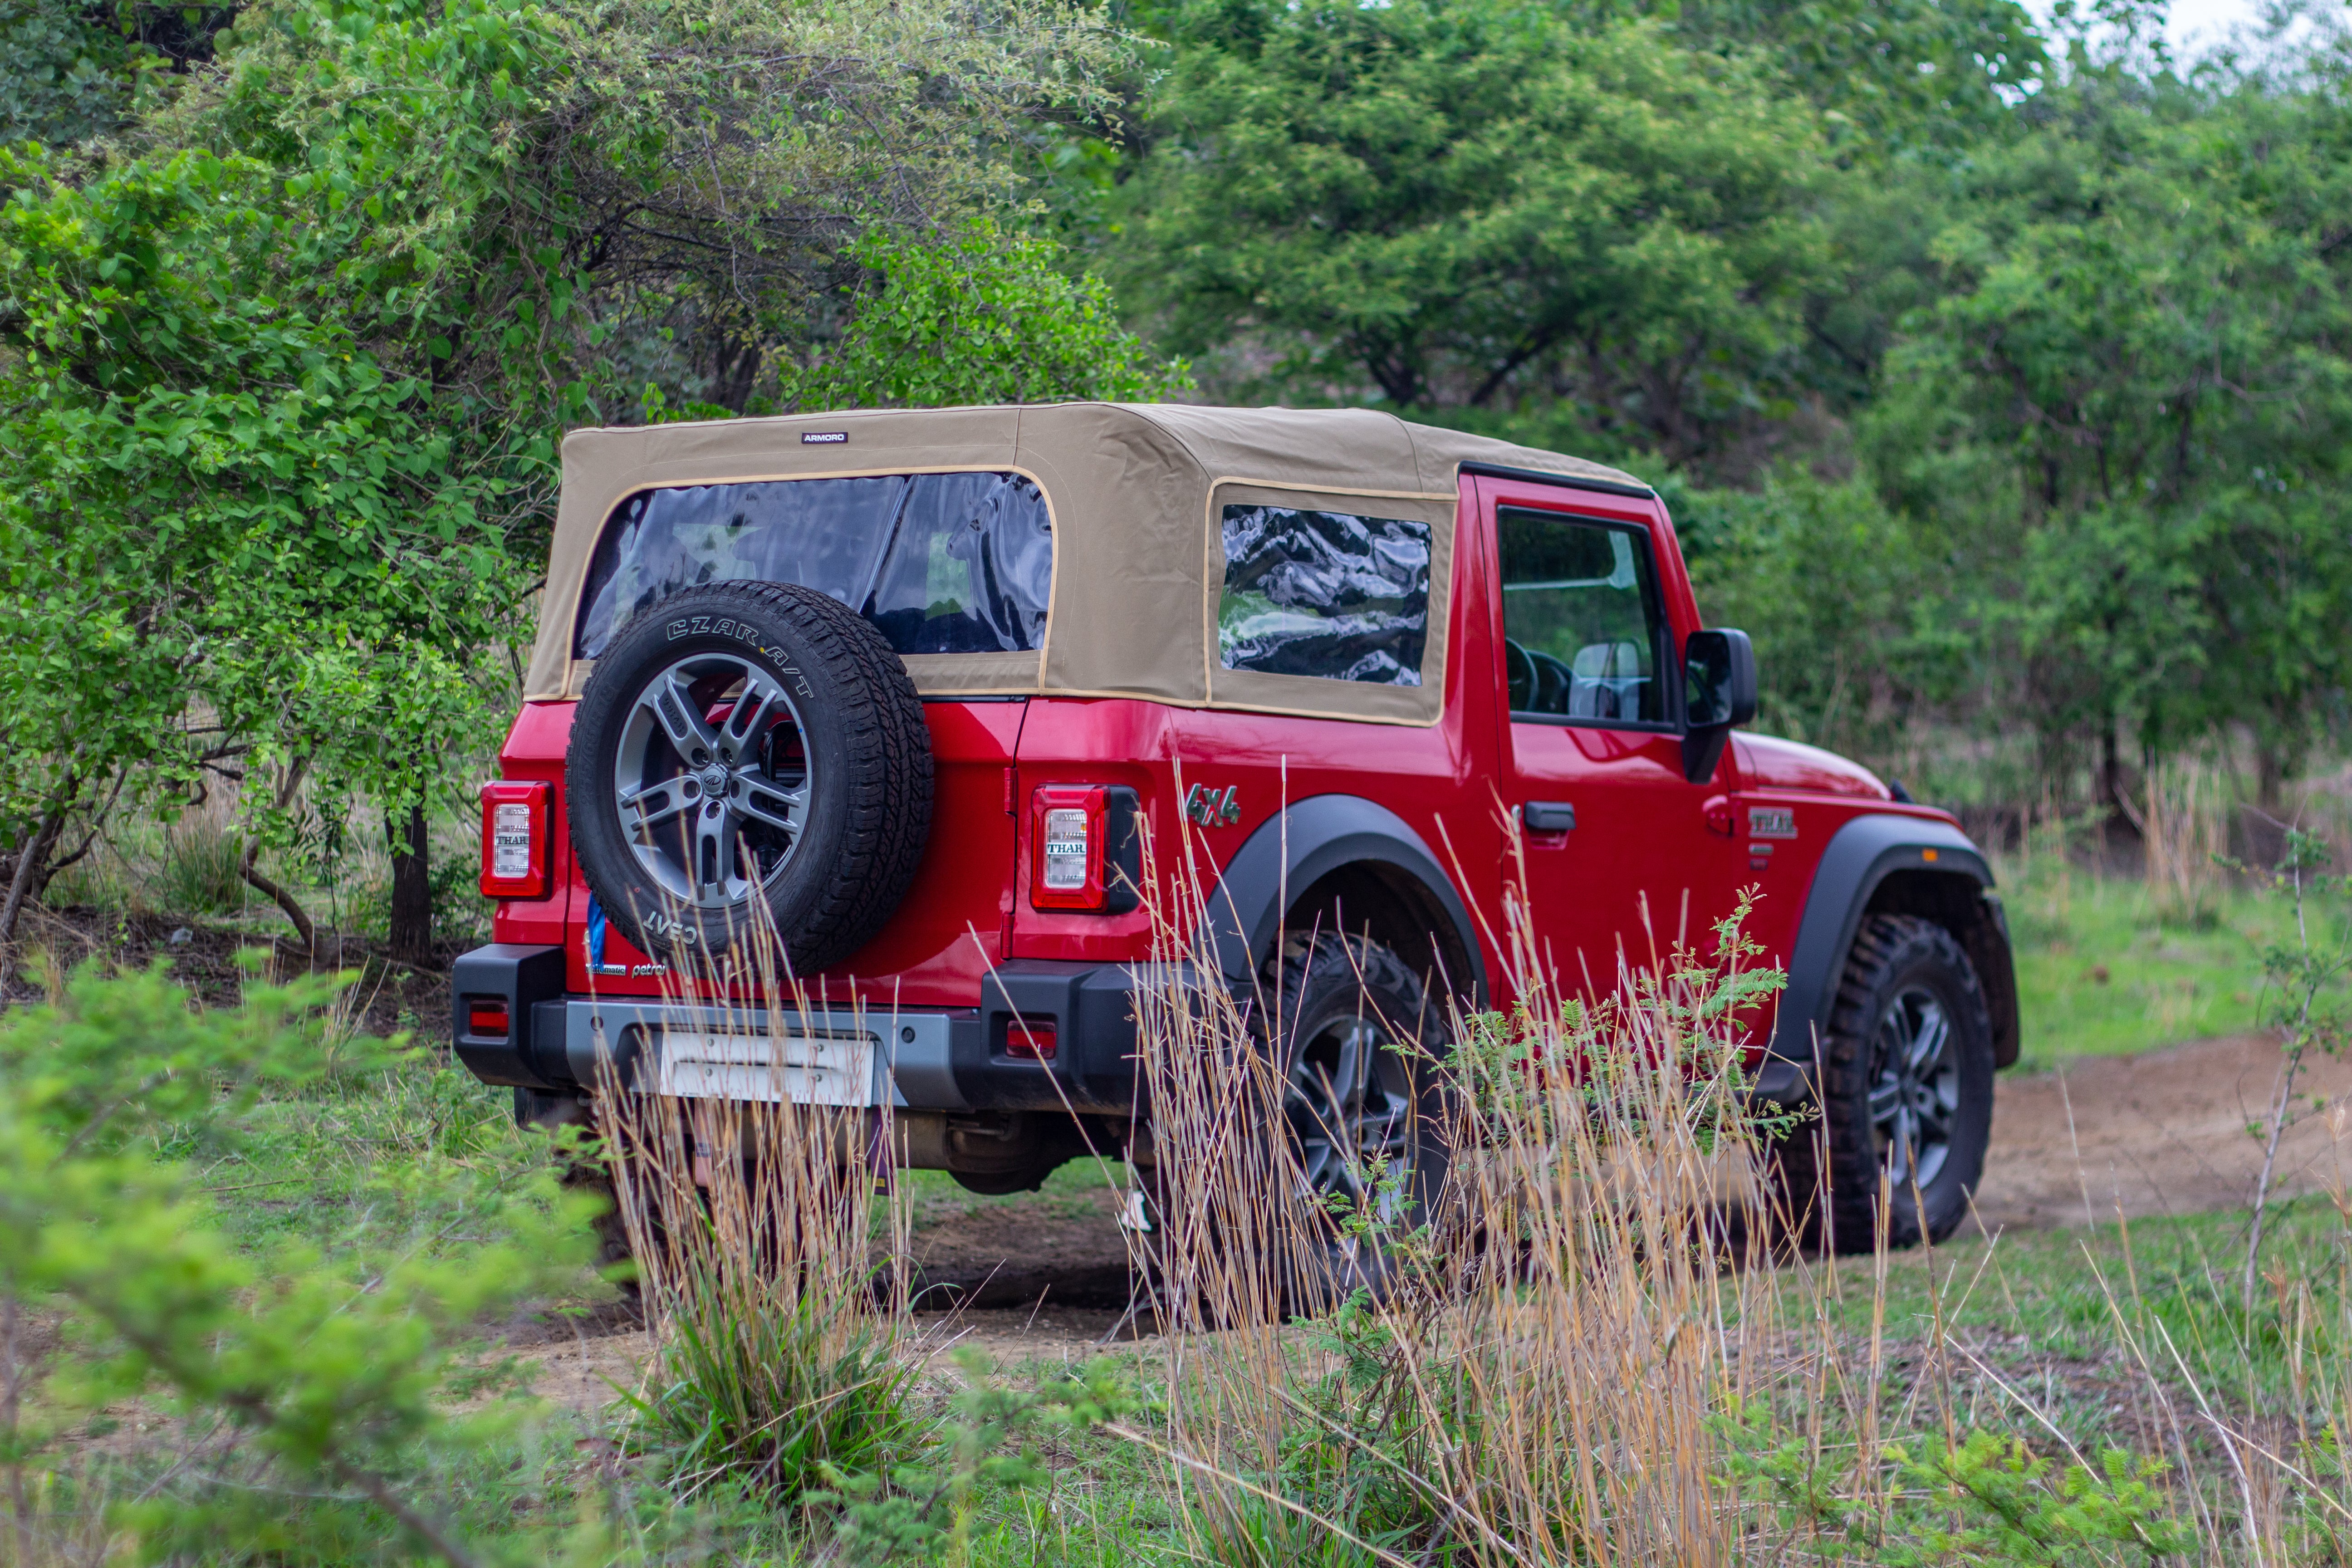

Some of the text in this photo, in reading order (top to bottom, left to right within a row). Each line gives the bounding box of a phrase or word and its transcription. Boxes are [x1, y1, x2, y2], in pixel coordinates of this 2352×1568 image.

[667, 616, 814, 698] CZAR A/T
[1048, 844, 1085, 853] THAR
[643, 911, 697, 945] CEAT
